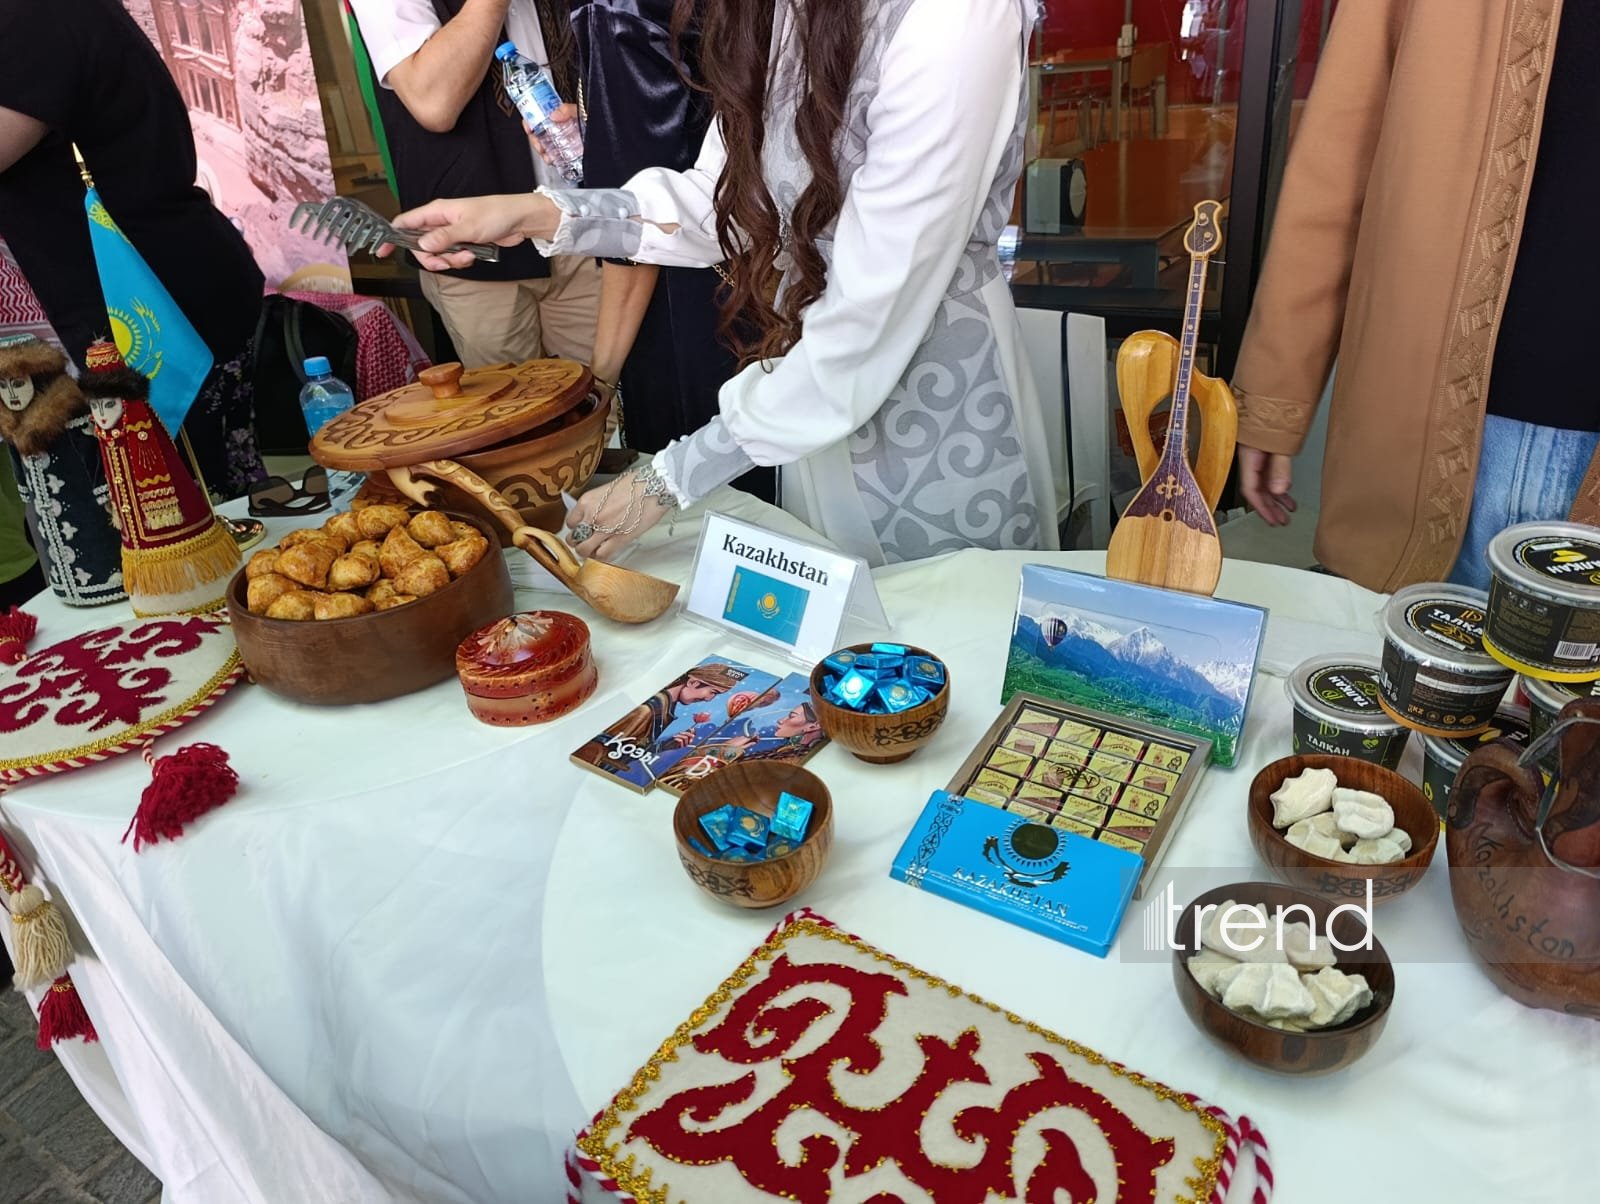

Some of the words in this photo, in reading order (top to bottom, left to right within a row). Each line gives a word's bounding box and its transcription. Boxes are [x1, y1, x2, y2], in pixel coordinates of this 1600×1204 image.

[722, 533, 828, 586] Kazakhstan
[1546, 560, 1600, 574] АЛКАН
[1432, 608, 1484, 635] ТАЛКА
[1328, 675, 1369, 708] ТАЛКАН
[1306, 733, 1351, 757] ТАЛКАН
[951, 865, 1069, 918] KAZAKHSTAN
